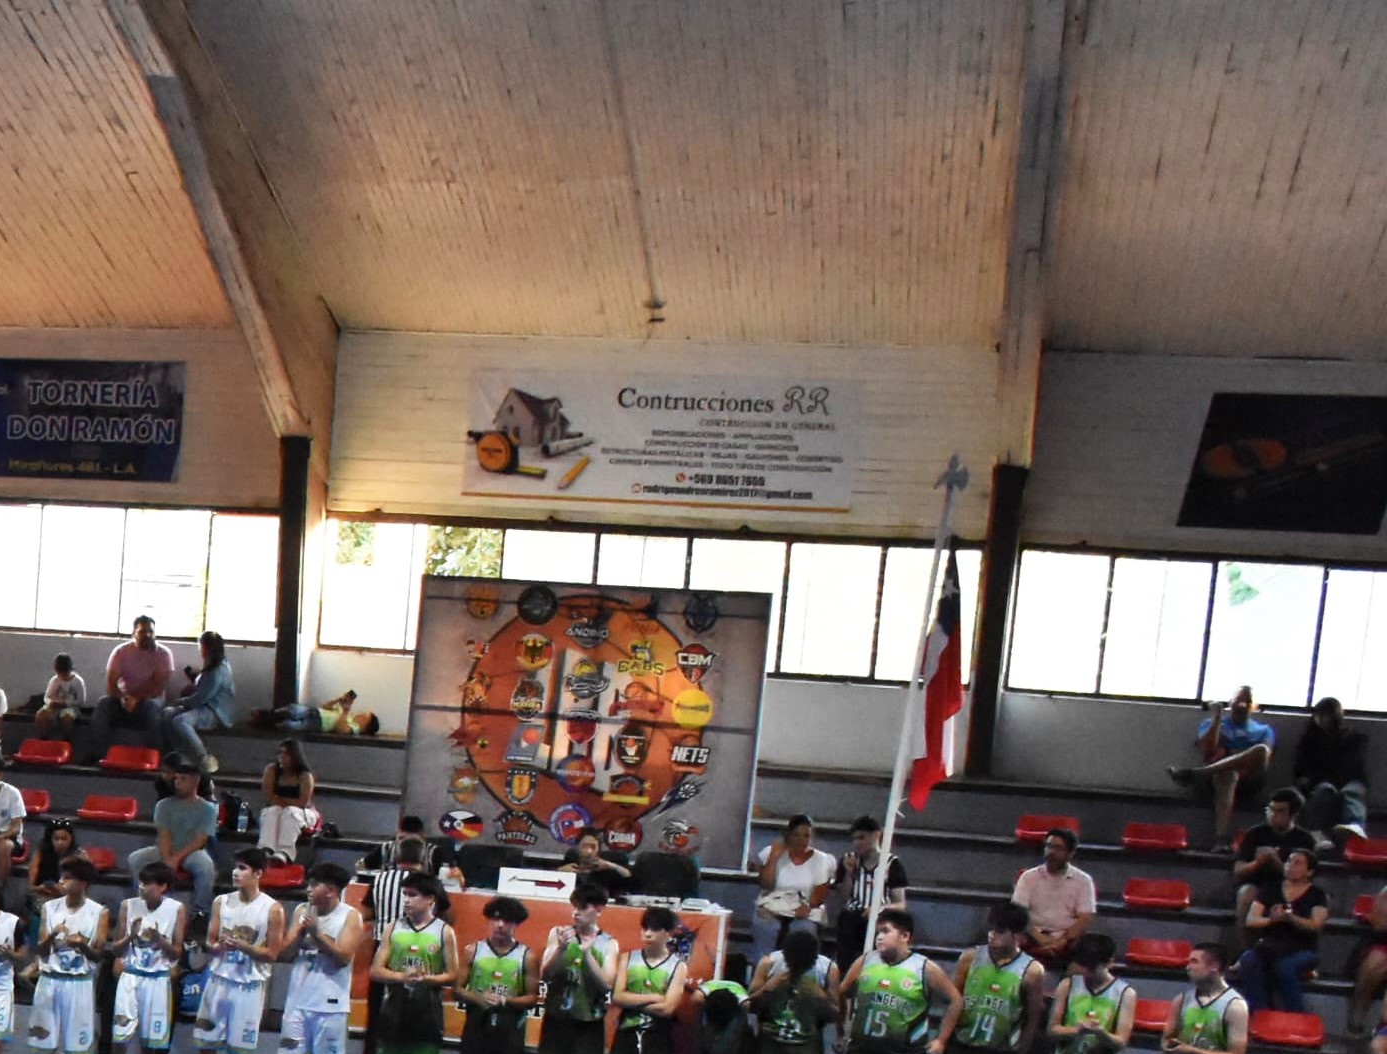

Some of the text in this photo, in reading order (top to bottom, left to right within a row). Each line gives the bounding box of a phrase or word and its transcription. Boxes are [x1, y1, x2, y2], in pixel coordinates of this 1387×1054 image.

[26, 378, 160, 408] TORNERÍA
[617, 386, 775, 413] Contrucciones
[6, 414, 68, 440] DON
[72, 412, 175, 444] RAMÓN
[677, 652, 714, 667] CBM
[671, 745, 710, 764] NETS
[862, 1008, 889, 1038] 15
[969, 1012, 996, 1042] 14
